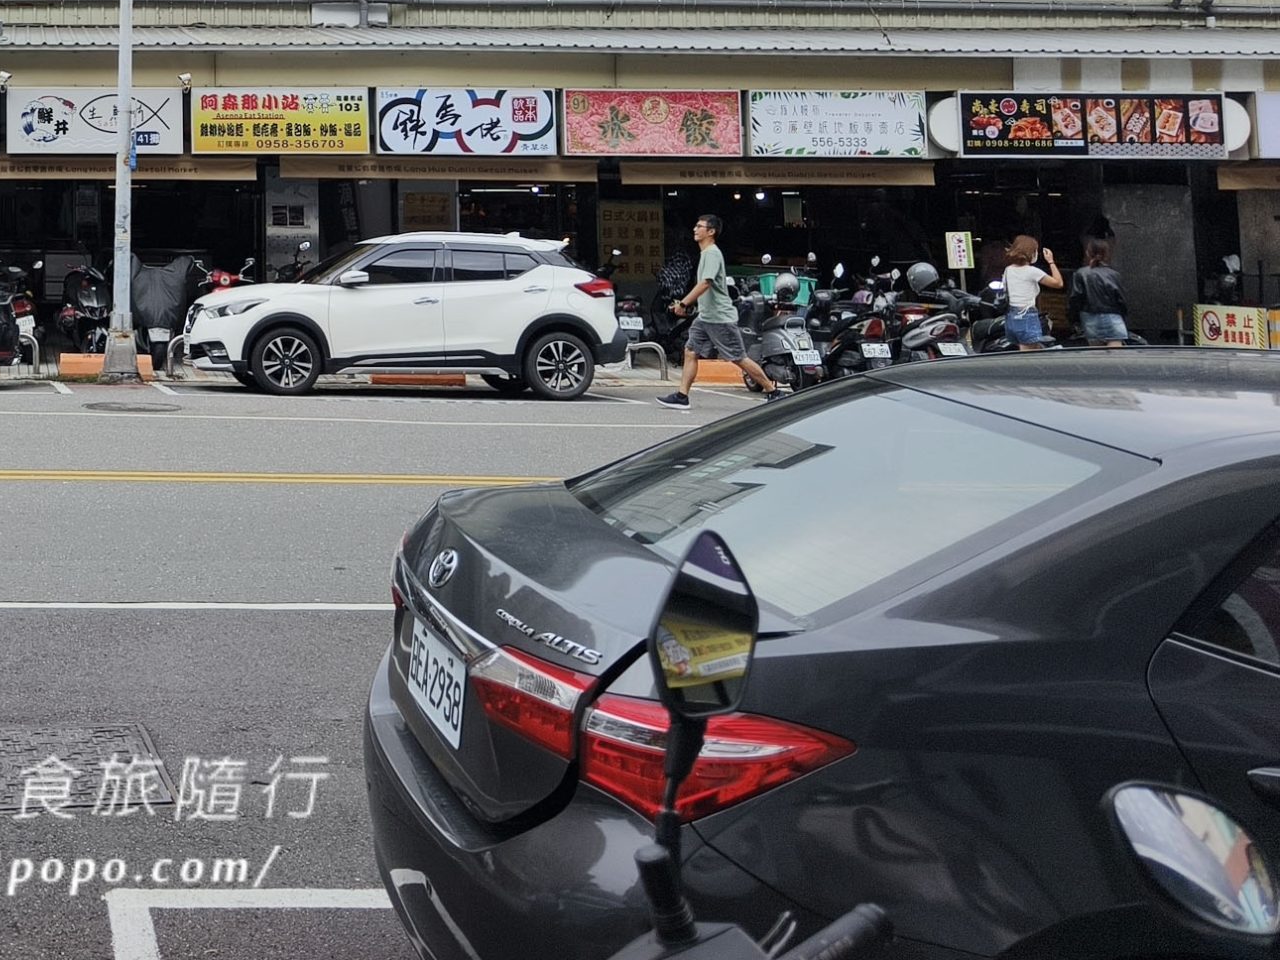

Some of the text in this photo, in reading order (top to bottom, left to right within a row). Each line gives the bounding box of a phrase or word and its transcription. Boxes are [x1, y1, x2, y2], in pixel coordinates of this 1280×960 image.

[339, 103, 360, 112] 103
[573, 98, 586, 110] 91
[256, 140, 344, 148] 0958-356703
[812, 137, 868, 148] 556-5333
[985, 139, 1053, 147] 0908-820-686
[1225, 313, 1255, 329] 禁止
[495, 607, 603, 666] COROLLA ALTIS
